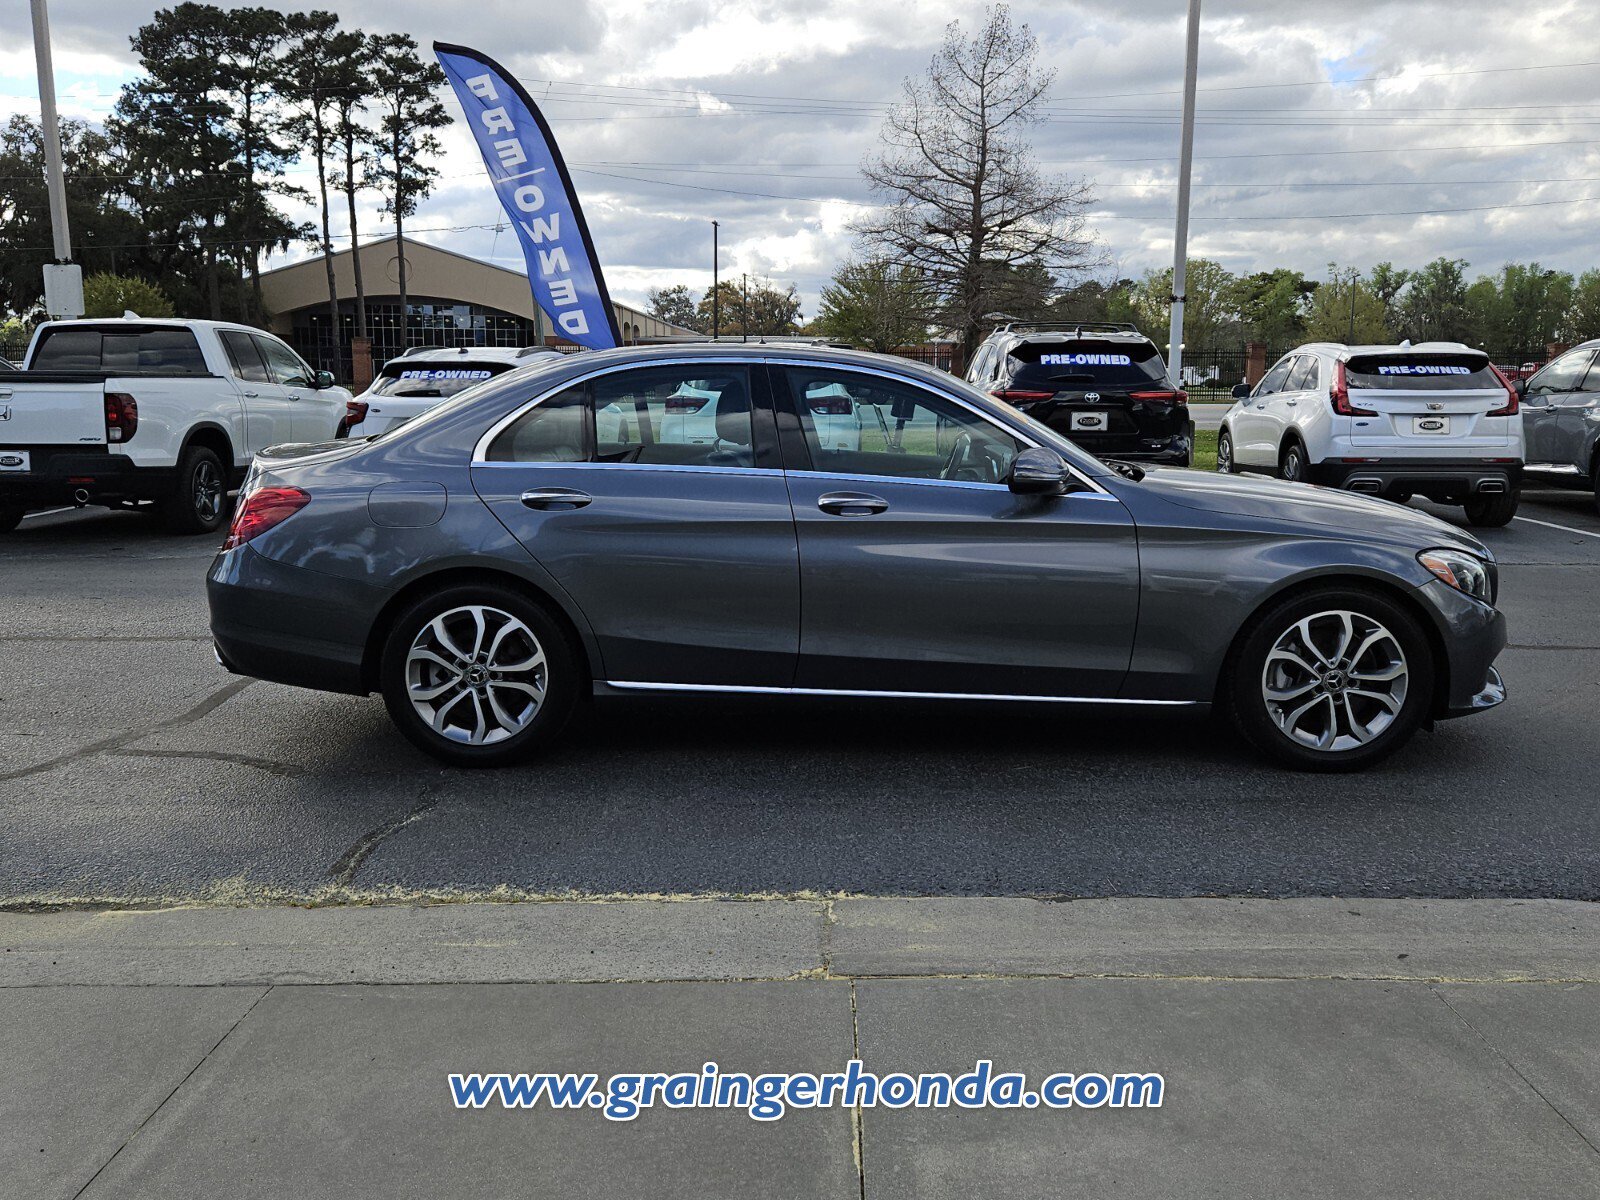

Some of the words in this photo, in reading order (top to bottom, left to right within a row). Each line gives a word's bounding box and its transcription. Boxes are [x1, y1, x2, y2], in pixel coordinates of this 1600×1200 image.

[1040, 354, 1131, 366] PRE-OWNED
[400, 370, 492, 379] PRE-OWNED
[1377, 365, 1471, 375] PRE-OWNED
